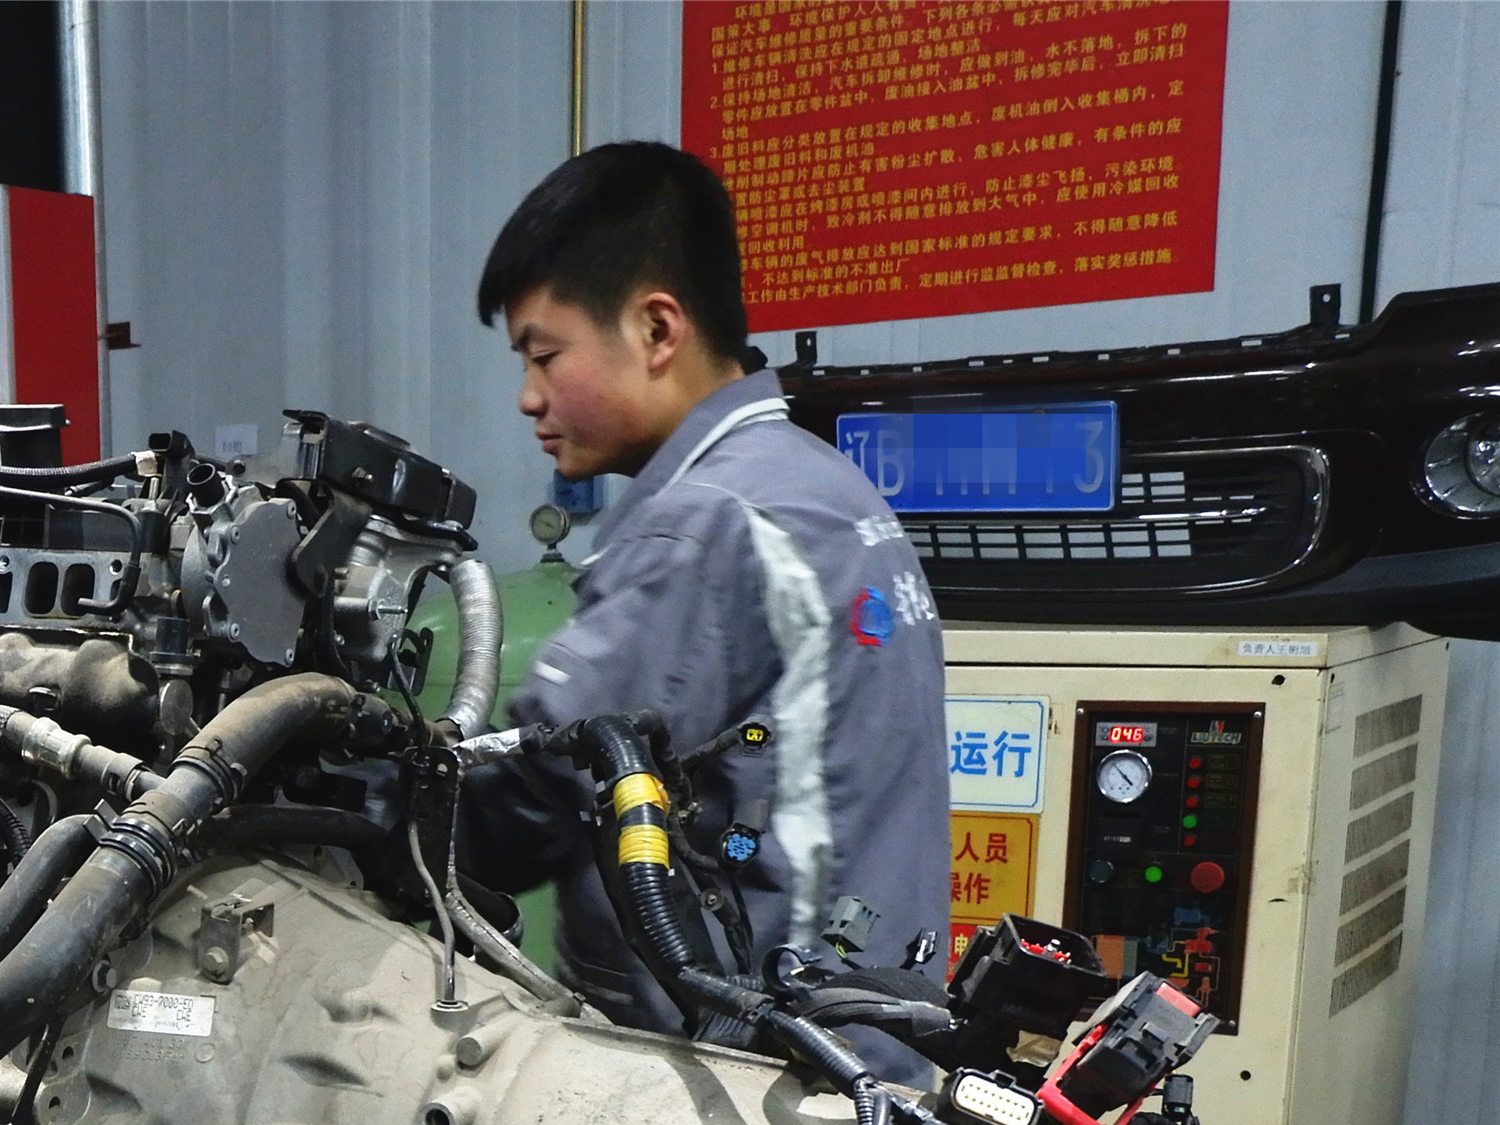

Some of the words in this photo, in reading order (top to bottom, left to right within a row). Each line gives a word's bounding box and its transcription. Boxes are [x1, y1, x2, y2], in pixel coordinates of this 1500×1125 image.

[1111, 727, 1143, 741] 046
[950, 731, 1031, 777] 运行
[950, 832, 1009, 864] 人员
